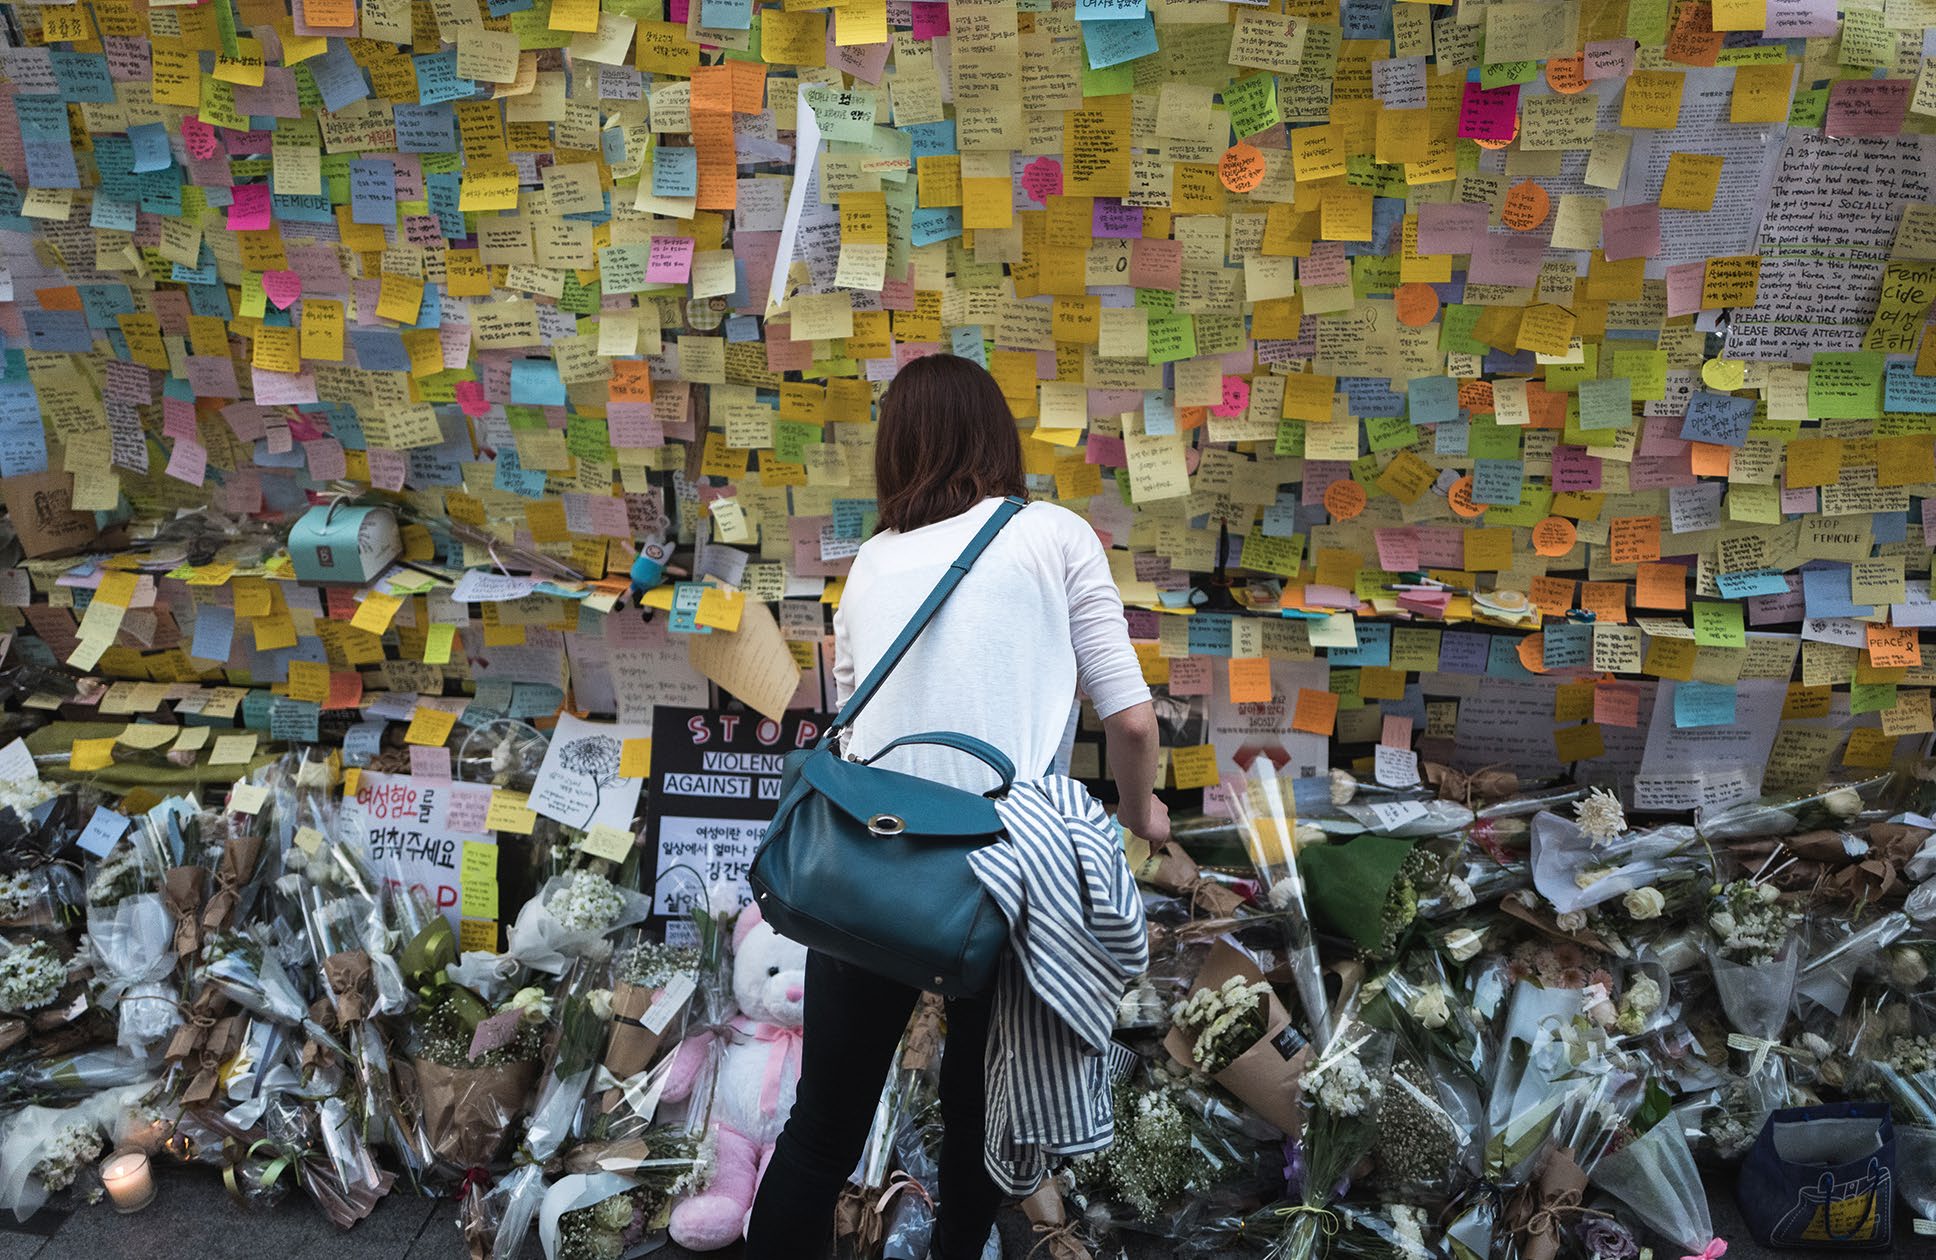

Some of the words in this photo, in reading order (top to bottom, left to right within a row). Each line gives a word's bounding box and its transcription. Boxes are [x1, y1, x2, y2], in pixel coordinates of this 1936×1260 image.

[1785, 147, 1794, 157] A
[1798, 149, 1858, 160] 23-year-old
[1864, 150, 1896, 160] woman
[1902, 153, 1921, 162] was
[1783, 162, 1819, 175] brutally
[1822, 165, 1869, 174] murdered
[1876, 166, 1888, 177] by
[1902, 169, 1926, 178] man
[1777, 174, 1802, 182] whom
[1805, 175, 1820, 184] she
[1826, 174, 1842, 184] had
[1847, 177, 1873, 186] never
[1877, 177, 1896, 188] met
[1772, 186, 1788, 196] The
[1817, 186, 1828, 195] he
[1831, 187, 1853, 196] killed
[1859, 188, 1872, 197] her
[1876, 189, 1883, 197] is
[1889, 190, 1928, 201] because
[273, 194, 330, 214] FEMICIDE
[1770, 201, 1782, 209] he
[1783, 200, 1797, 211] got
[1765, 212, 1778, 221] He
[1819, 212, 1833, 221] his
[1837, 213, 1866, 223] anger
[1871, 213, 1882, 223] by
[1777, 223, 1814, 232] innocent
[1760, 233, 1776, 244] The
[1778, 235, 1798, 247] point
[1802, 235, 1809, 243] is
[1811, 235, 1830, 244] that
[1834, 235, 1850, 245] she
[1853, 238, 1870, 246] was
[1778, 247, 1806, 256] because
[1810, 248, 1825, 257] she
[1827, 250, 1835, 258] is
[1850, 250, 1892, 261] FEMALE
[1782, 259, 1810, 267] similar
[1814, 259, 1824, 267] to
[1827, 259, 1844, 269] this
[1849, 259, 1878, 272] happen
[1759, 271, 1784, 283] quently
[1788, 270, 1796, 278] in
[1851, 273, 1876, 281] media
[1760, 282, 1792, 292] covering
[1763, 292, 1769, 300] is
[1817, 293, 1850, 303] gender
[1776, 302, 1792, 310] and
[1735, 313, 1771, 324] PLEASE
[1775, 313, 1813, 324] MOURN
[1816, 315, 1837, 326] THIS
[1880, 309, 1920, 332] 여성
[1732, 325, 1768, 336] PLEASE
[1774, 327, 1808, 338] BRING
[1812, 328, 1866, 338] ATTENTIO
[1728, 338, 1743, 348] We
[1745, 338, 1757, 346] all
[1760, 338, 1778, 346] have
[1790, 339, 1810, 350] right
[1827, 340, 1842, 348] live
[1870, 327, 1917, 352] 살해
[1727, 350, 1755, 358] secure
[1809, 519, 1840, 530] STOP
[1813, 533, 1861, 543] FEMICIDE
[1899, 629, 1913, 638] IN
[1869, 638, 1904, 648] PEACE
[687, 715, 820, 748] STOP
[705, 754, 783, 773] VIOLENC
[664, 775, 751, 796] AGAINST
[356, 784, 435, 824] 여성혐오를
[696, 827, 741, 841] 여성이란
[369, 826, 455, 869] 멈춰주세요
[662, 842, 708, 856] 일상에서
[713, 842, 748, 857] 얼마나
